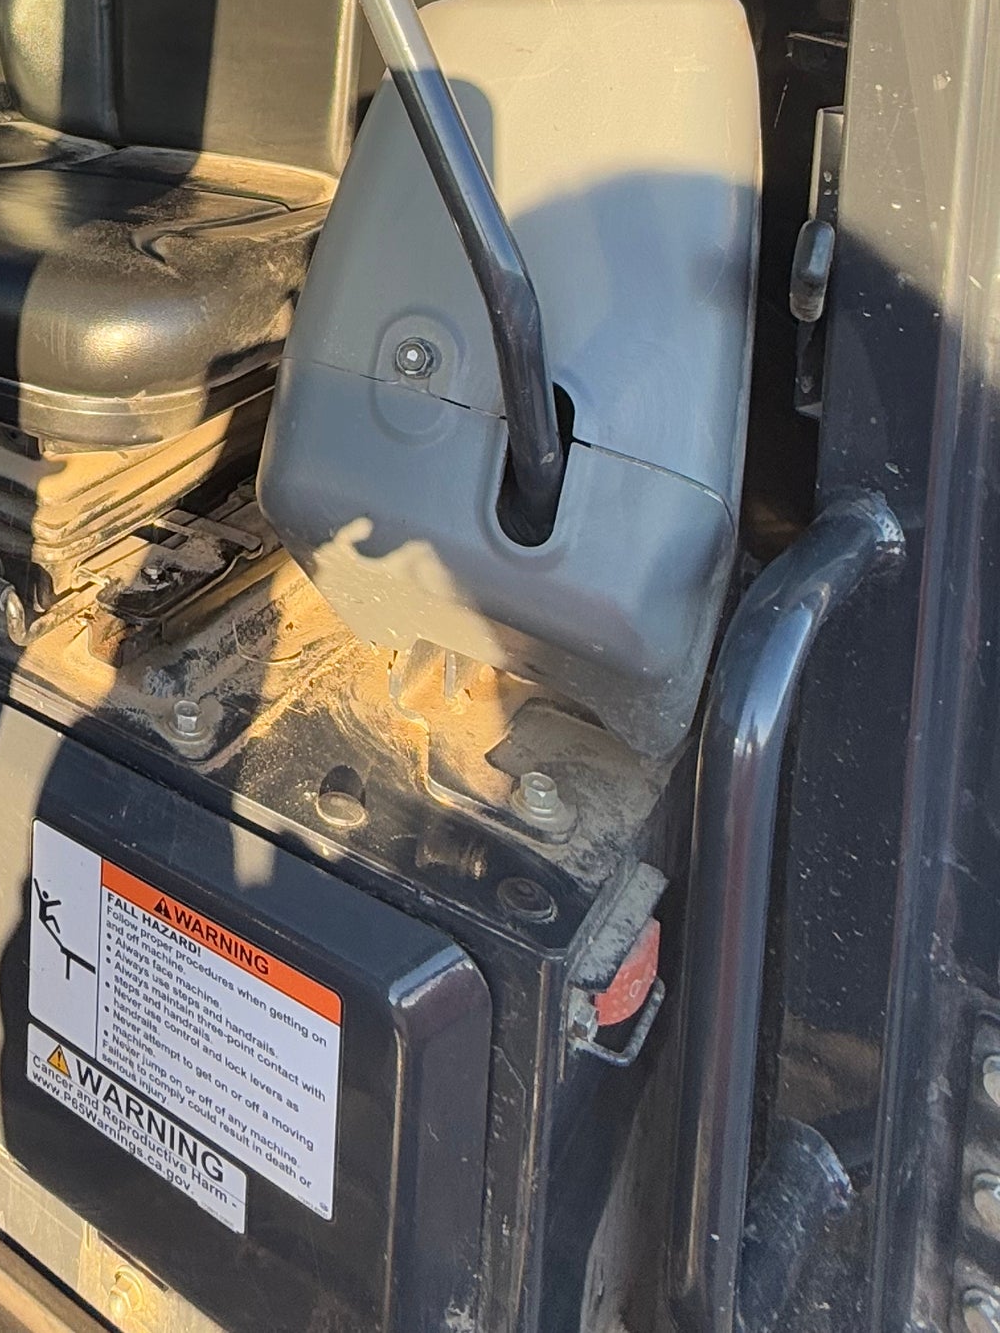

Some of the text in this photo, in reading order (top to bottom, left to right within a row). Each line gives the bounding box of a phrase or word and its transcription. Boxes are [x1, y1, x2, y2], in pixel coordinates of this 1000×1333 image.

[106, 919, 185, 975] and off machine.
[106, 905, 326, 1047] Follow proper procedures when getting on
[107, 892, 201, 957] FALL HAZARD!
[115, 937, 221, 1010] Always face machine.
[174, 905, 268, 975] WARNING
[112, 1023, 155, 1057] machine.
[113, 997, 160, 1035] handrails.
[113, 985, 299, 1112] Never use control and lock levers as
[114, 949, 277, 1058] Always use steps and handrails.
[114, 974, 212, 1043] steps and handrails.
[114, 962, 325, 1102] Always maintain three-point contact with
[31, 1071, 194, 1195] www.P65Warnings.ca.gov.
[32, 1054, 73, 1095] Cancer
[76, 1089, 98, 1114] and
[102, 1104, 187, 1174] Reproductive
[191, 1167, 228, 1204] Harm
[75, 1058, 223, 1183] WARNING
[101, 1052, 166, 1103] serious injury.
[102, 1039, 311, 1188] Failure to comply could result in death or
[112, 1009, 313, 1152] Never attempt to get on or off a moving
[112, 1034, 297, 1166] Never jump on or off of any machine.
